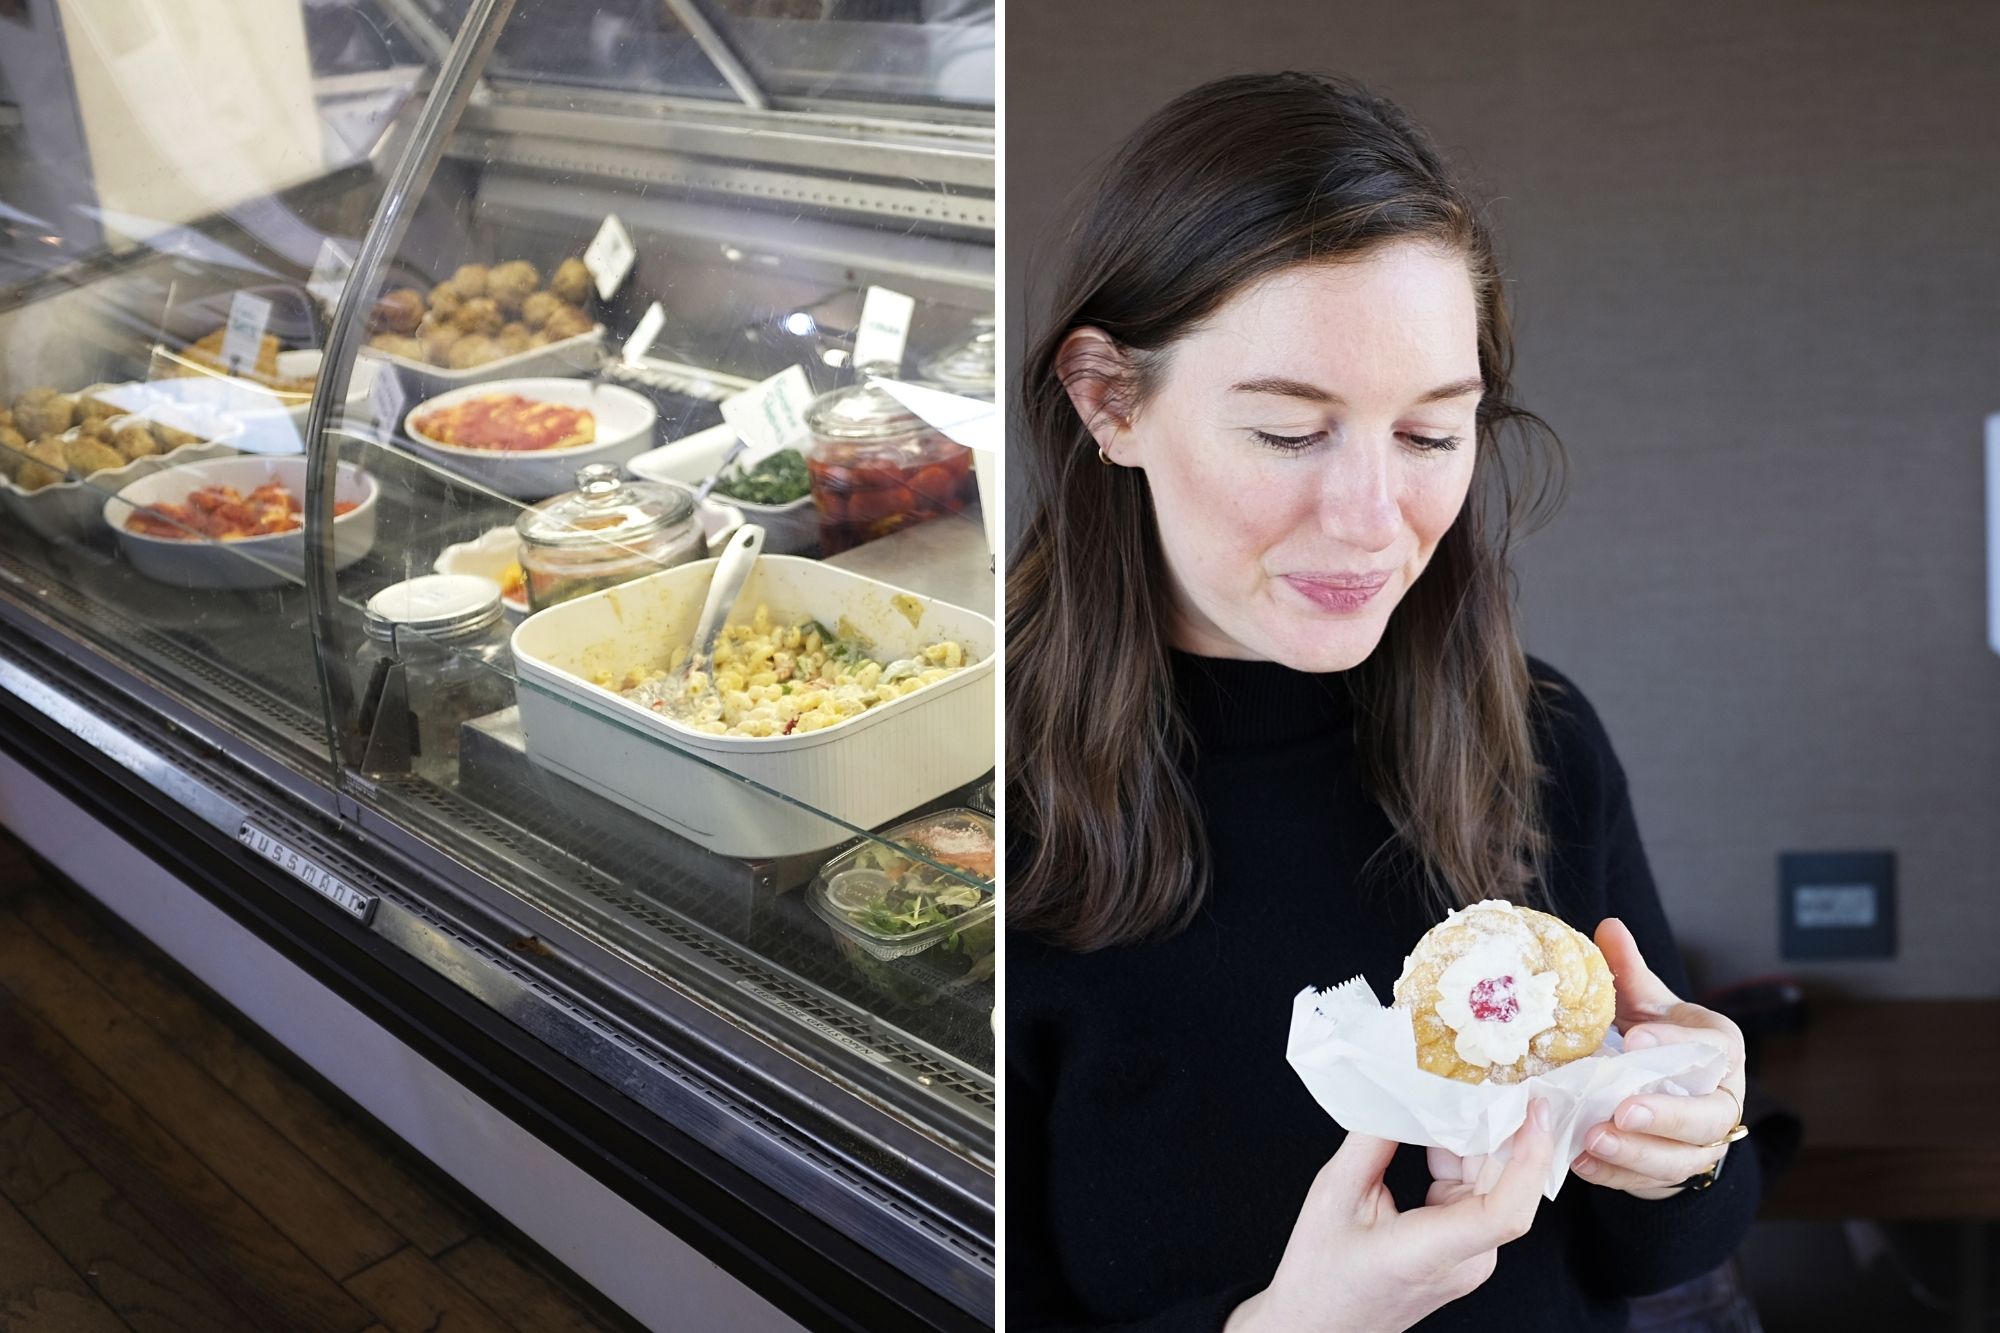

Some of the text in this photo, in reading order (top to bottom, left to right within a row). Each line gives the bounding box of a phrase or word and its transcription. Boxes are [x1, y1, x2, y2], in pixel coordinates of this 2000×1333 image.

[750, 987, 874, 1055] KEEP THESE GRILLS OPEN
